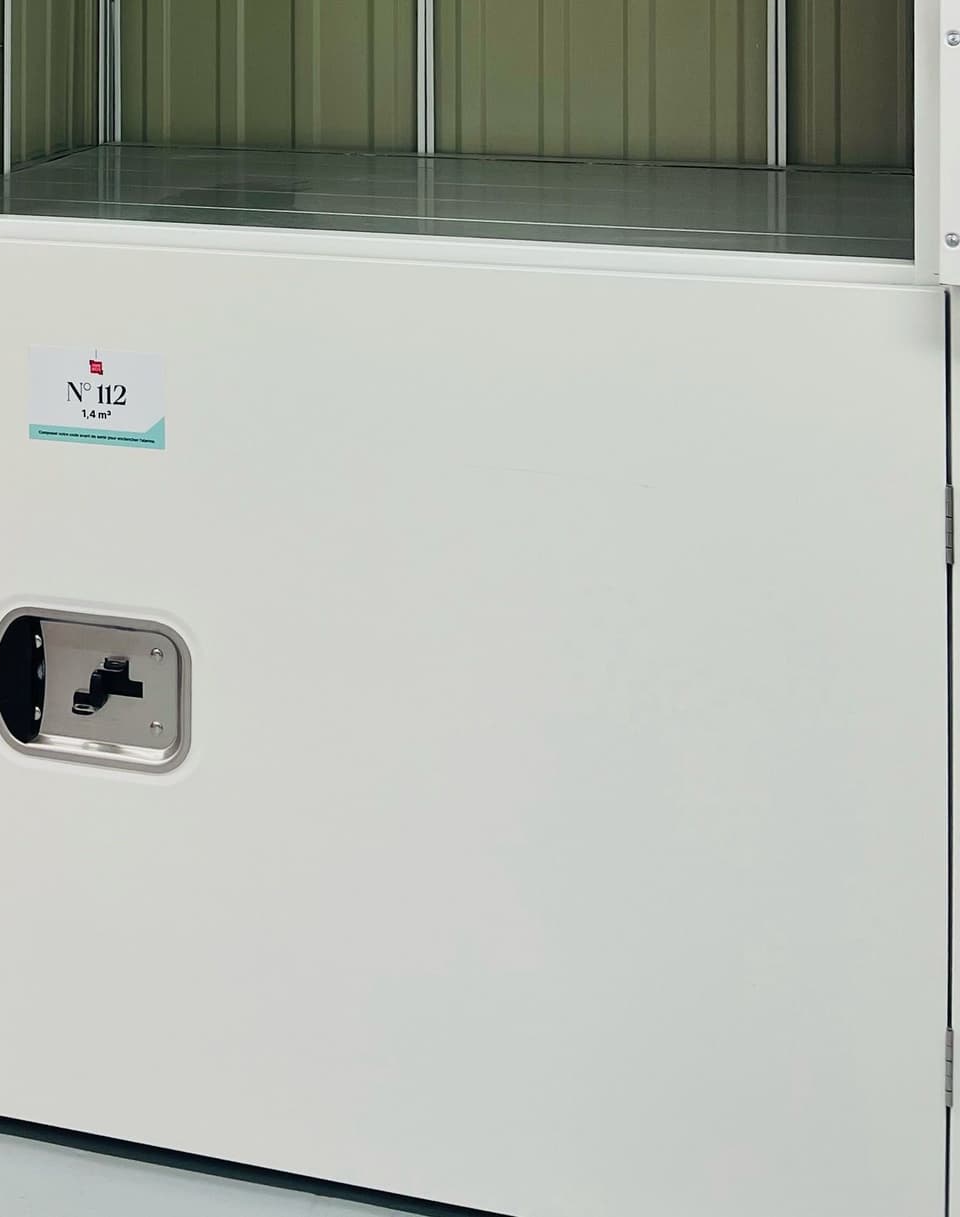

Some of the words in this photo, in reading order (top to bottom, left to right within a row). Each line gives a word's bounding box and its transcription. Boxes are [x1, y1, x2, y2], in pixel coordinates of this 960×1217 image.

[97, 384, 127, 406] 112
[81, 409, 96, 420] 1,4
[97, 410, 112, 420] m³
